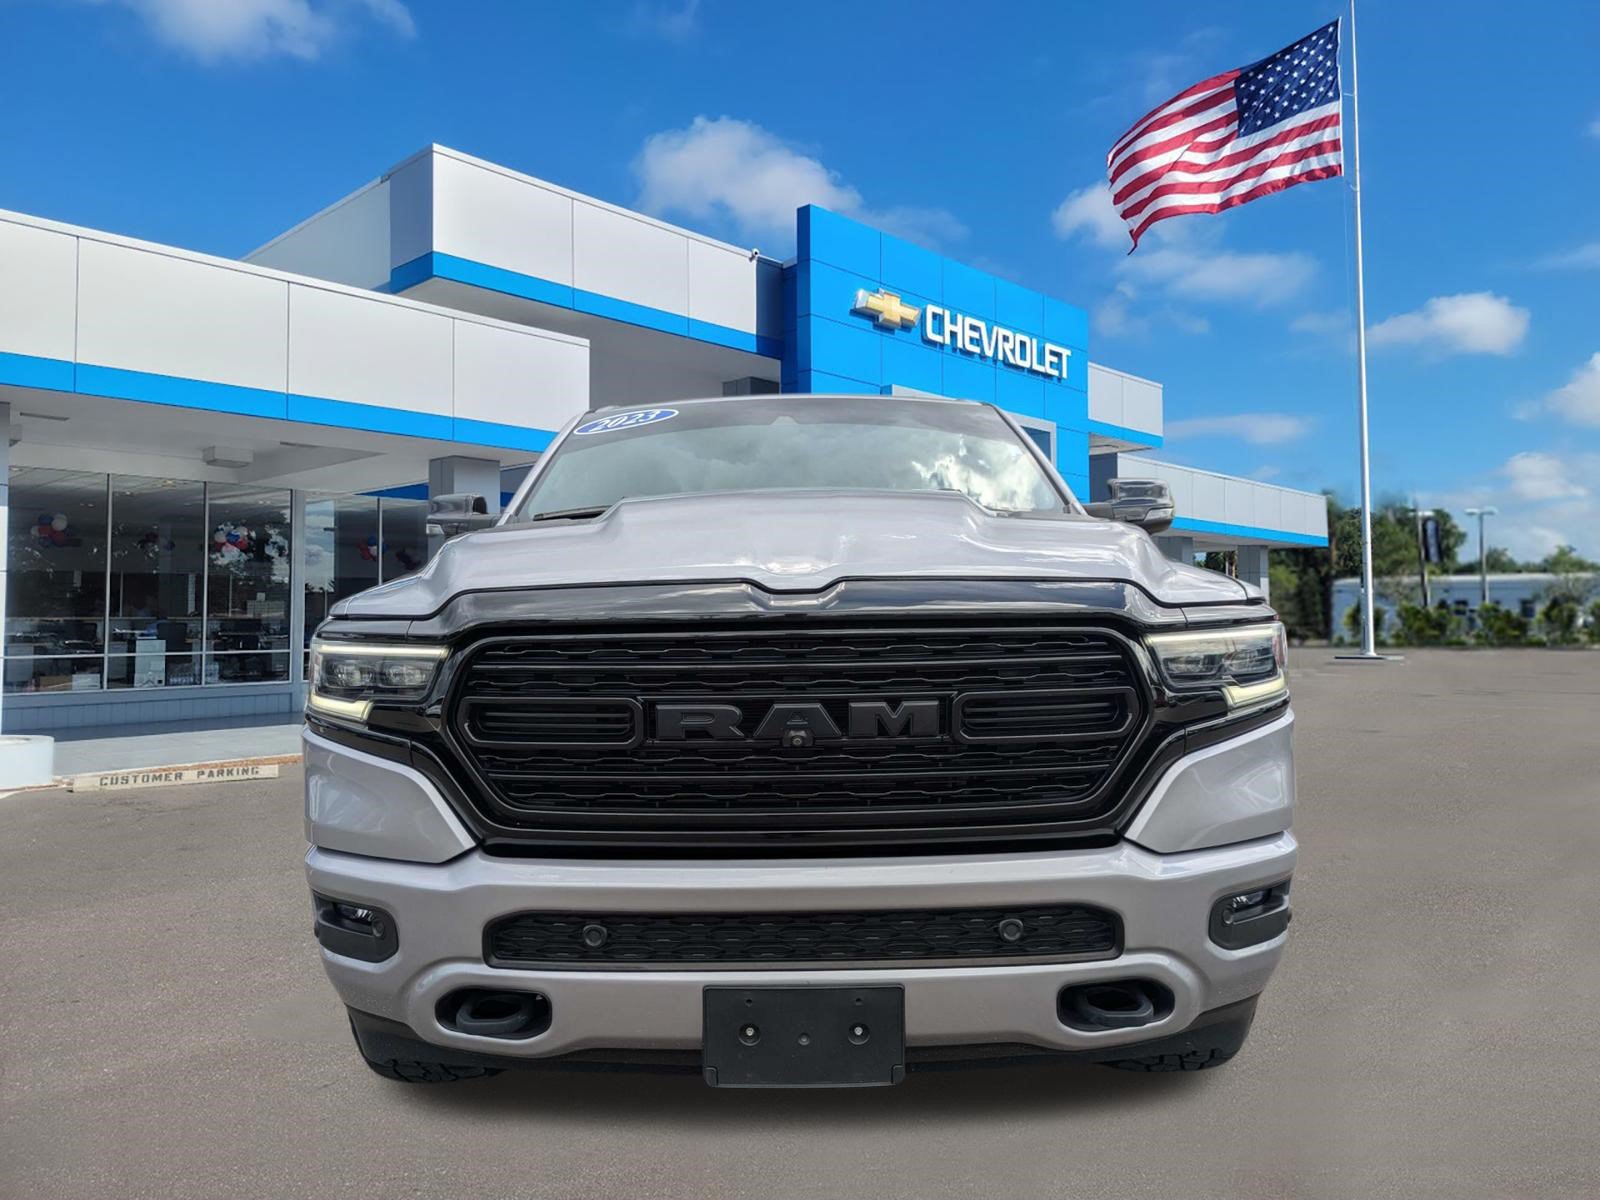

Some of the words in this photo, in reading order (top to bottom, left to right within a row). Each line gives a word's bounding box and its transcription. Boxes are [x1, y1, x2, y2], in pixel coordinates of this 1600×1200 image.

[925, 304, 1072, 379] CHEVROLET
[587, 409, 661, 432] 2023
[655, 700, 940, 738] RAM
[99, 772, 184, 787] CUSTOMER
[196, 766, 260, 779] PARKING
